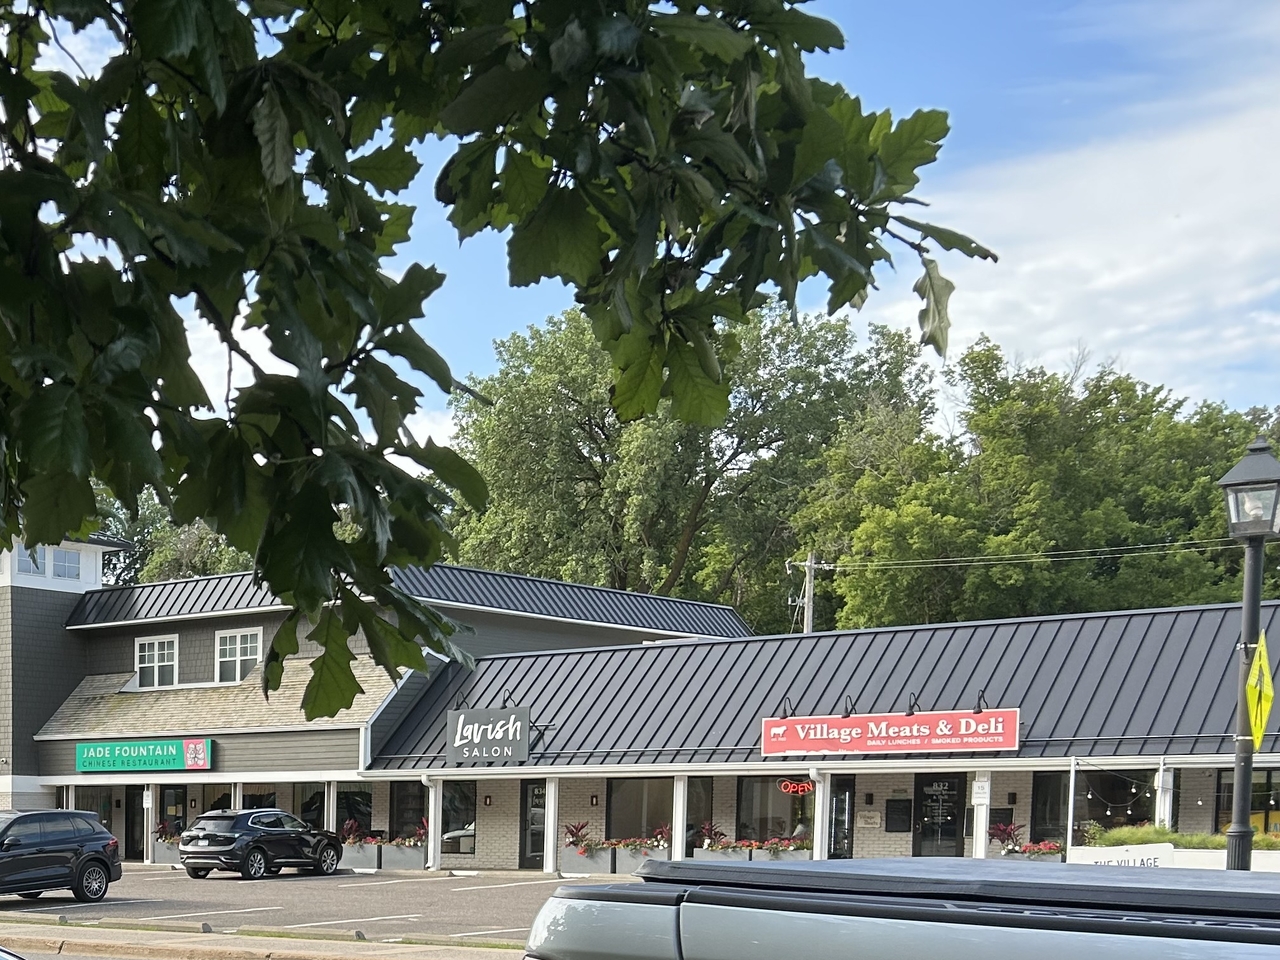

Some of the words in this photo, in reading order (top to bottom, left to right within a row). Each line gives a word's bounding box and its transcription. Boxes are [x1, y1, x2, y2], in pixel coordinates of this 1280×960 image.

[453, 714, 521, 748] Lavish
[795, 723, 862, 743] Village
[867, 721, 931, 738] Meats
[936, 719, 954, 735] &
[959, 717, 1005, 735] Deli
[82, 747, 111, 758] JADE
[115, 744, 177, 757] FOUNTAIN
[463, 746, 513, 758] SALON
[82, 760, 116, 768] CHINESE
[121, 758, 177, 767] RESTAURANT
[781, 780, 814, 795] OPEN
[932, 782, 949, 790] 832
[1117, 857, 1159, 868] VILLAGE
